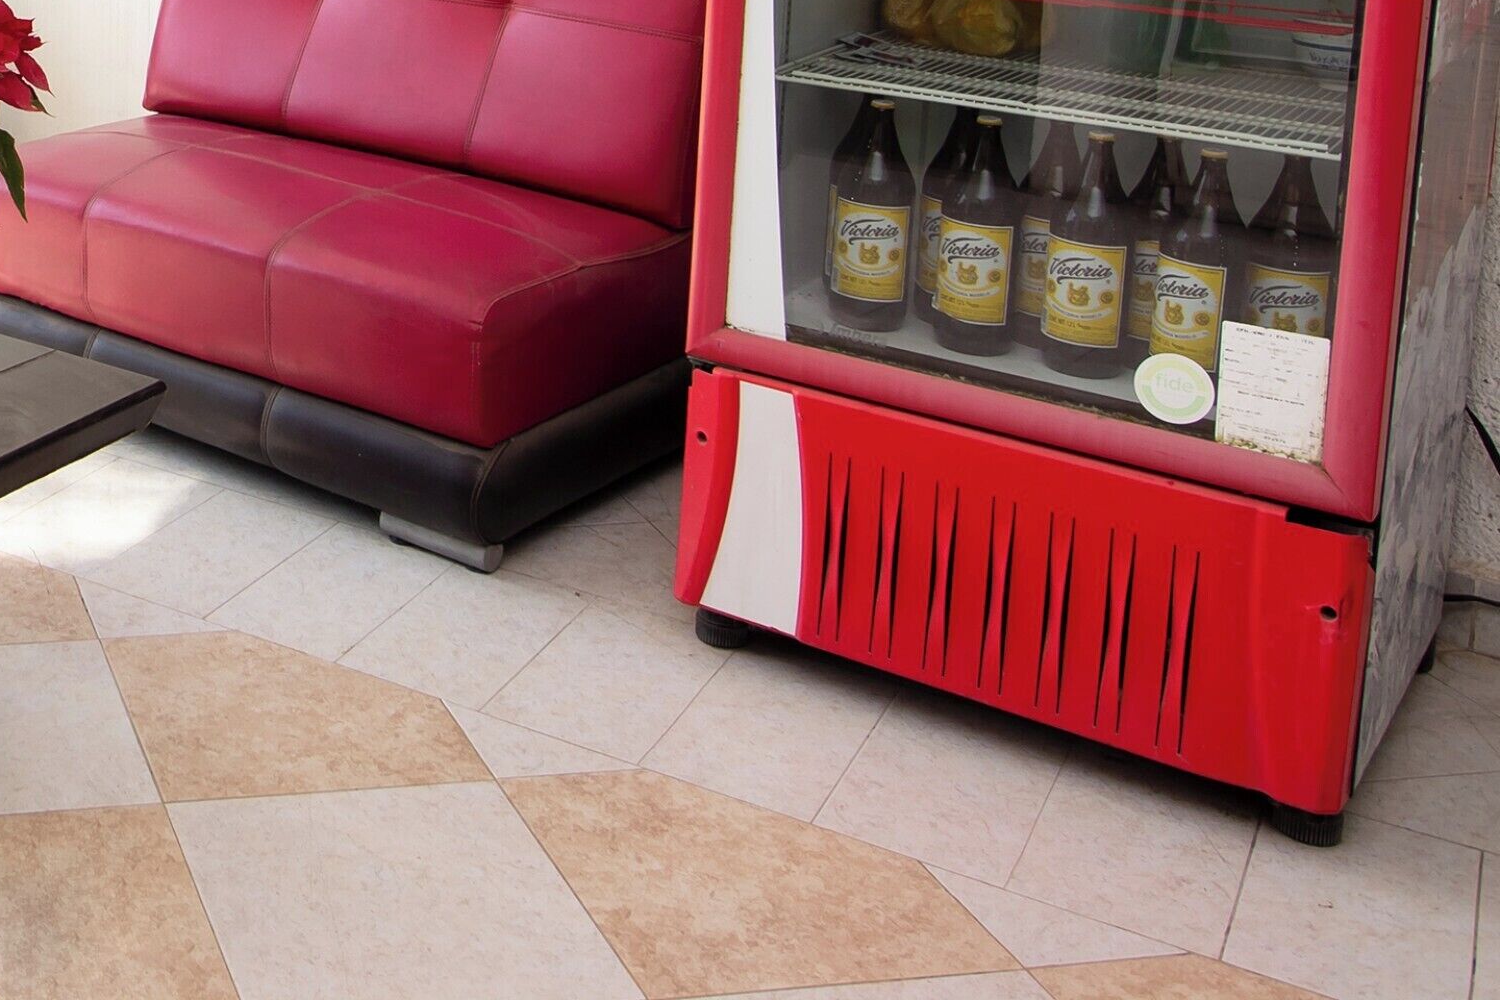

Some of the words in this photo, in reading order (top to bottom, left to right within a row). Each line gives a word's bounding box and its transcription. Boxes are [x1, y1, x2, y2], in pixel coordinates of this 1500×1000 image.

[840, 218, 899, 245] Victoria
[942, 237, 1000, 264] Victoria
[1050, 257, 1113, 284] Victoria
[1250, 285, 1320, 314] Victoria
[1155, 372, 1196, 394] fide
